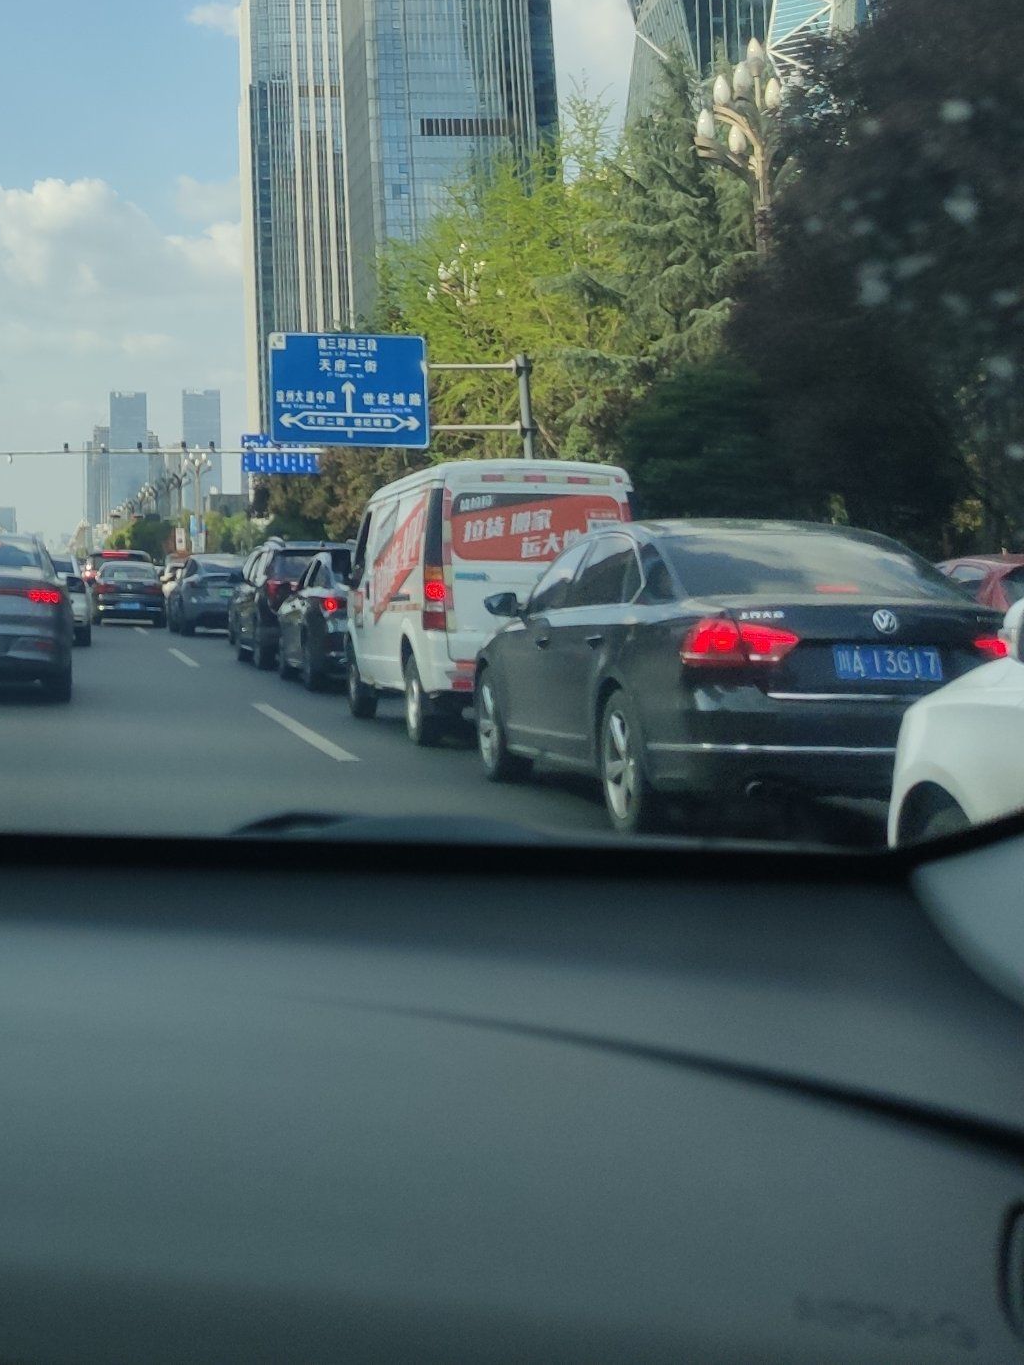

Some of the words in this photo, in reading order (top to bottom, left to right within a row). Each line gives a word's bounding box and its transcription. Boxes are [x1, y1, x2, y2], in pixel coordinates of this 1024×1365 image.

[318, 358, 378, 373] 天府一街
[362, 392, 422, 406] 世纪城路
[307, 417, 345, 426] 天府二街
